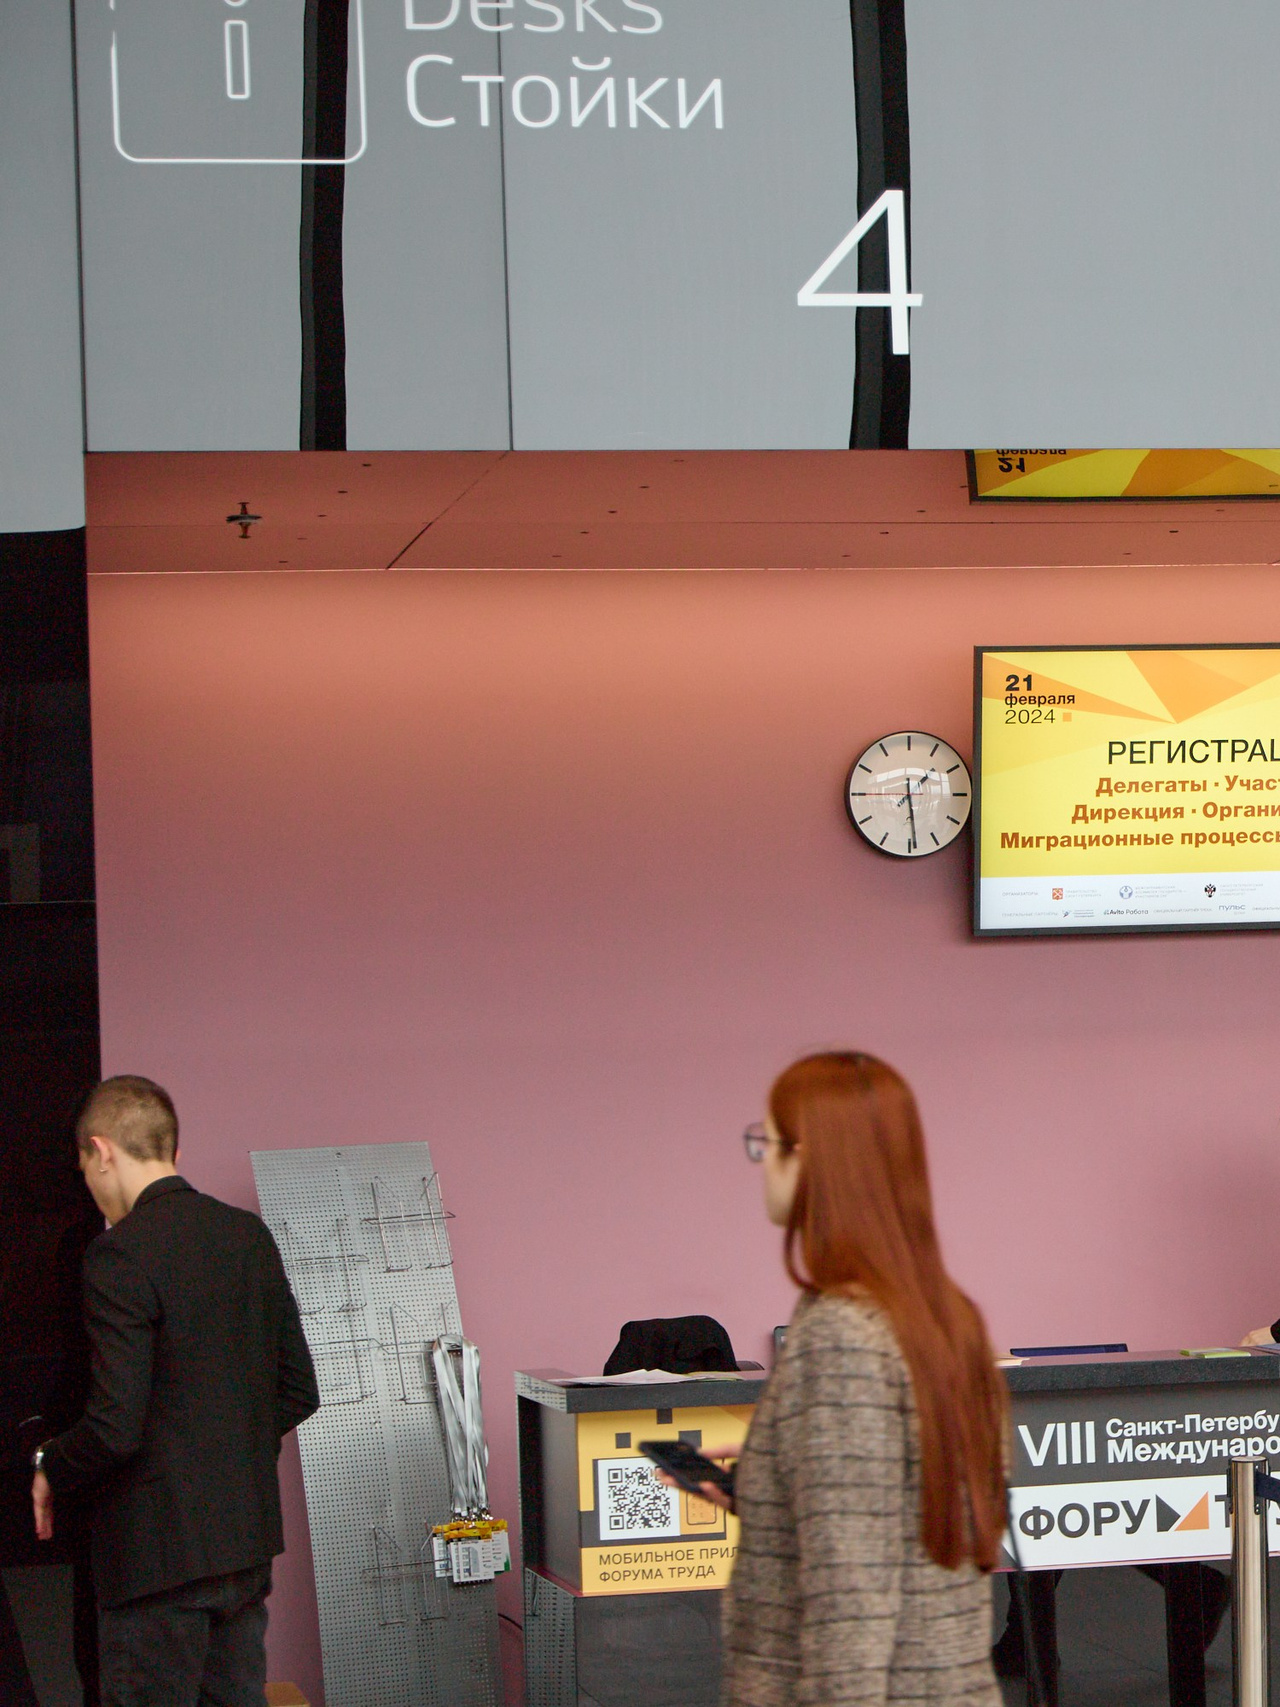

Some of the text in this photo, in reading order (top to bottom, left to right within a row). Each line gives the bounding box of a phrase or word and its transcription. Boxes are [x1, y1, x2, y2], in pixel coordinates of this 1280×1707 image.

[405, 54, 724, 130] Стойки
[797, 189, 923, 355] 4
[1005, 675, 1034, 692] 21
[1004, 692, 1076, 707] февраля
[1004, 709, 1056, 725] 2024
[1095, 776, 1208, 796] Делегаты
[1071, 804, 1186, 824] Дирекция
[1000, 831, 1175, 852] Миграционные
[1018, 1420, 1097, 1467] VIII
[1018, 1498, 1152, 1541] ФОРУ
[599, 1549, 695, 1566] МОБИЛЬНОЕ
[599, 1565, 716, 1583] ФОРУМА ТРУДА
